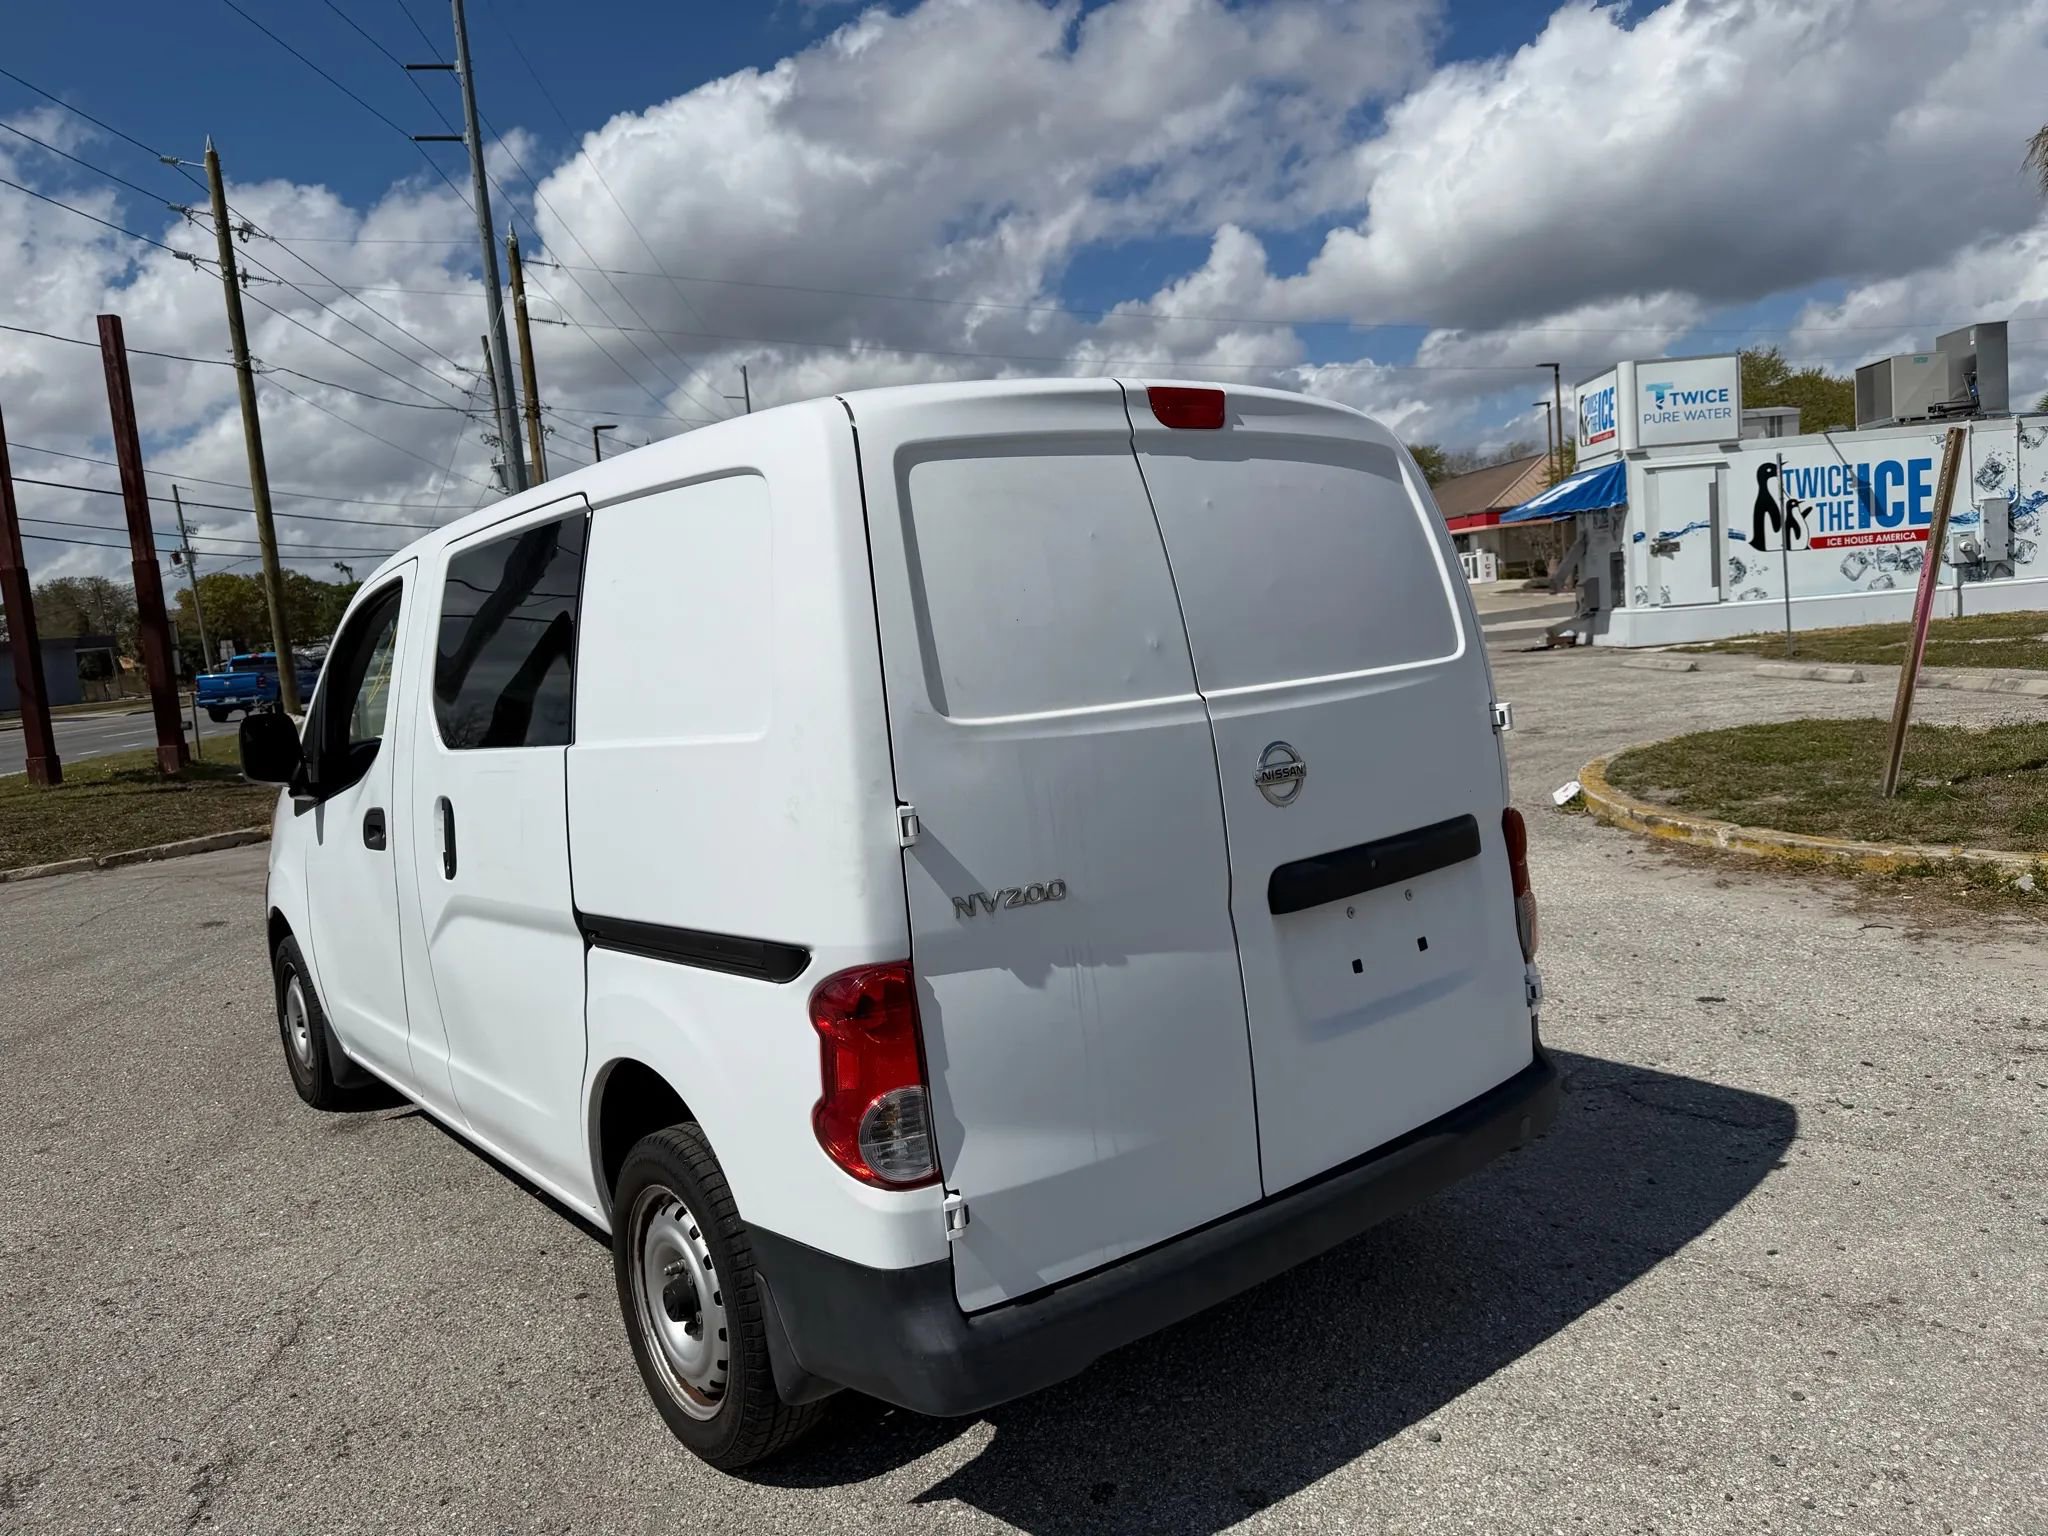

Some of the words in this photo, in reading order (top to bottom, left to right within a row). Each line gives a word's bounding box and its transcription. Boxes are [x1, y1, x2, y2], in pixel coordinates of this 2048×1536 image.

[1598, 386, 1615, 431] ICE
[1669, 388, 1729, 406] TWICE
[1643, 411, 1681, 425] PURE
[1684, 407, 1732, 421] WATER
[1782, 464, 1854, 500] TWICE
[1857, 457, 1933, 529] ICE
[1815, 500, 1855, 533] THE
[1826, 537, 1843, 547] ICE
[1844, 534, 1874, 545] HOUSE
[1875, 531, 1917, 543] AMERICA
[1261, 764, 1304, 781] NISSAN
[951, 878, 1067, 919] NV200
